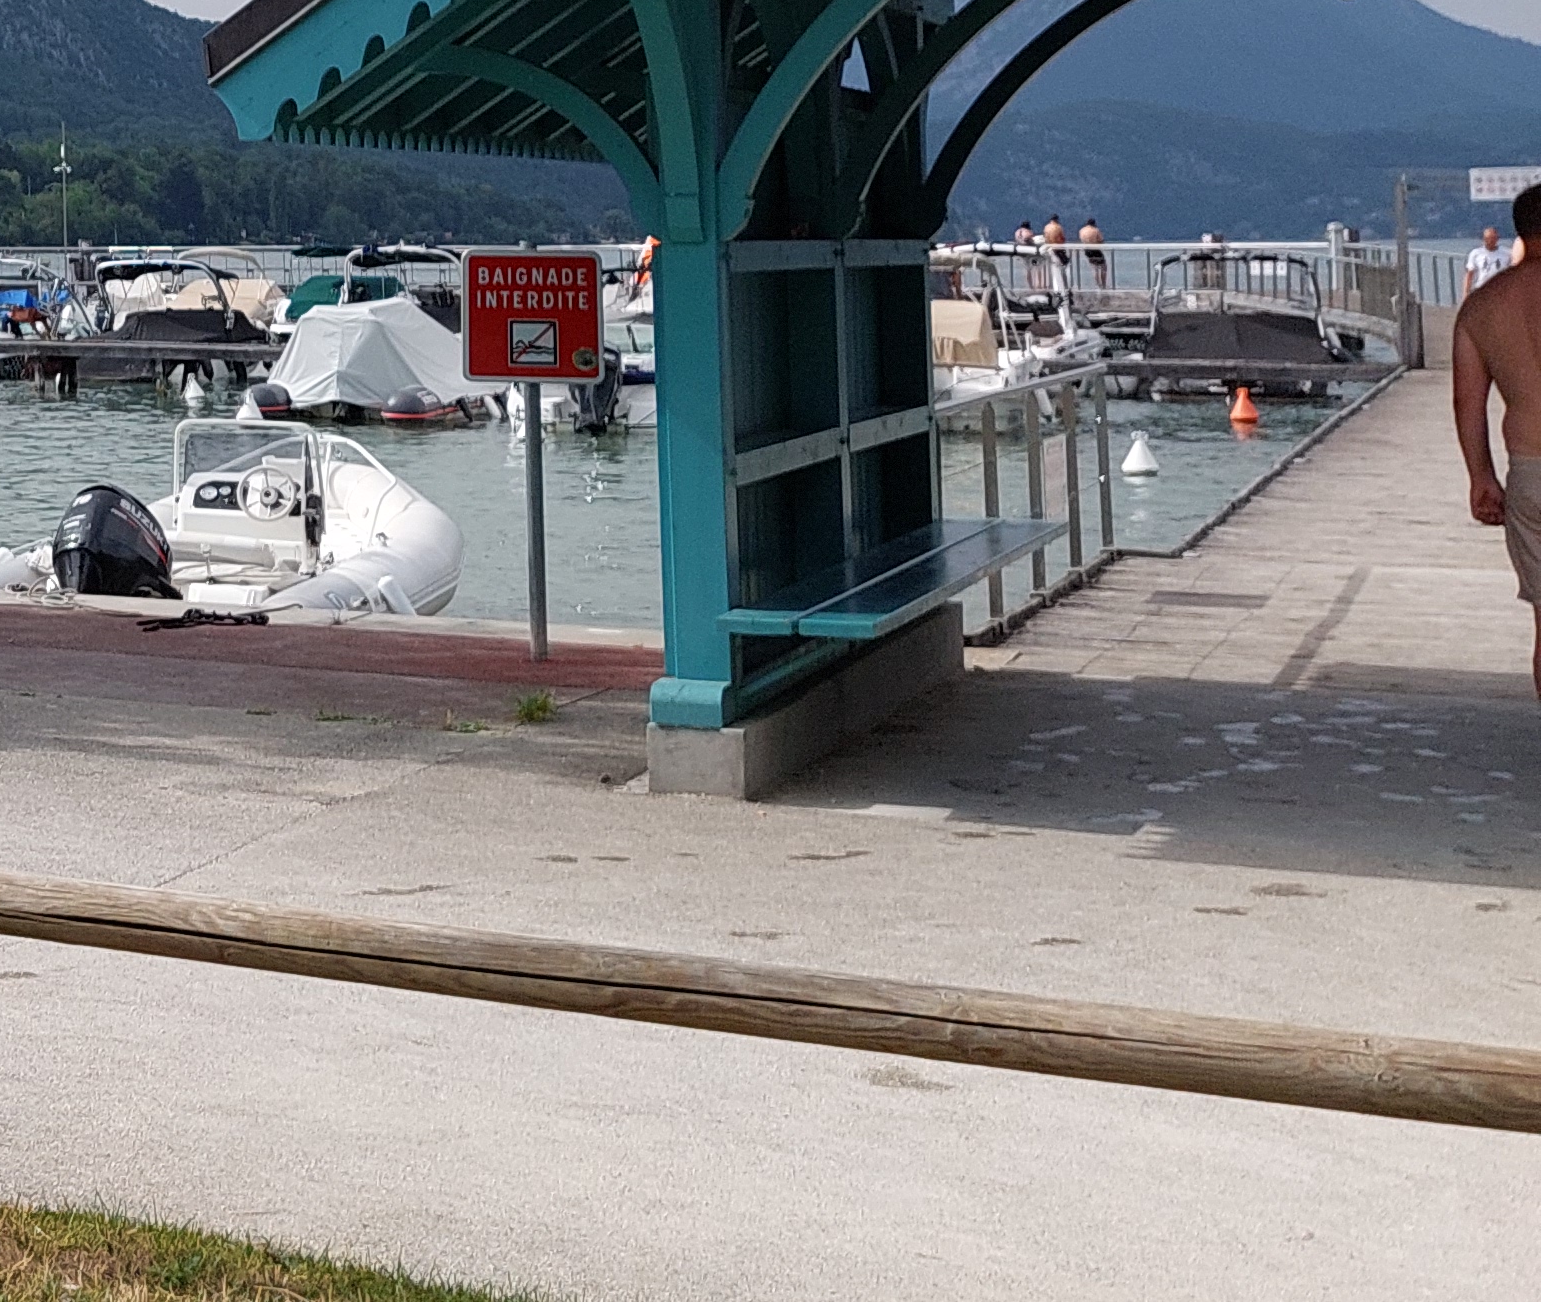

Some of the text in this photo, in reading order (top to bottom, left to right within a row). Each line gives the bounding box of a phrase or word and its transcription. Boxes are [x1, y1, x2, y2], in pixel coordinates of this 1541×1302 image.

[477, 266, 588, 286] BAIGNADE
[476, 290, 590, 310] INTERDITE
[119, 498, 168, 554] SUZUKI
